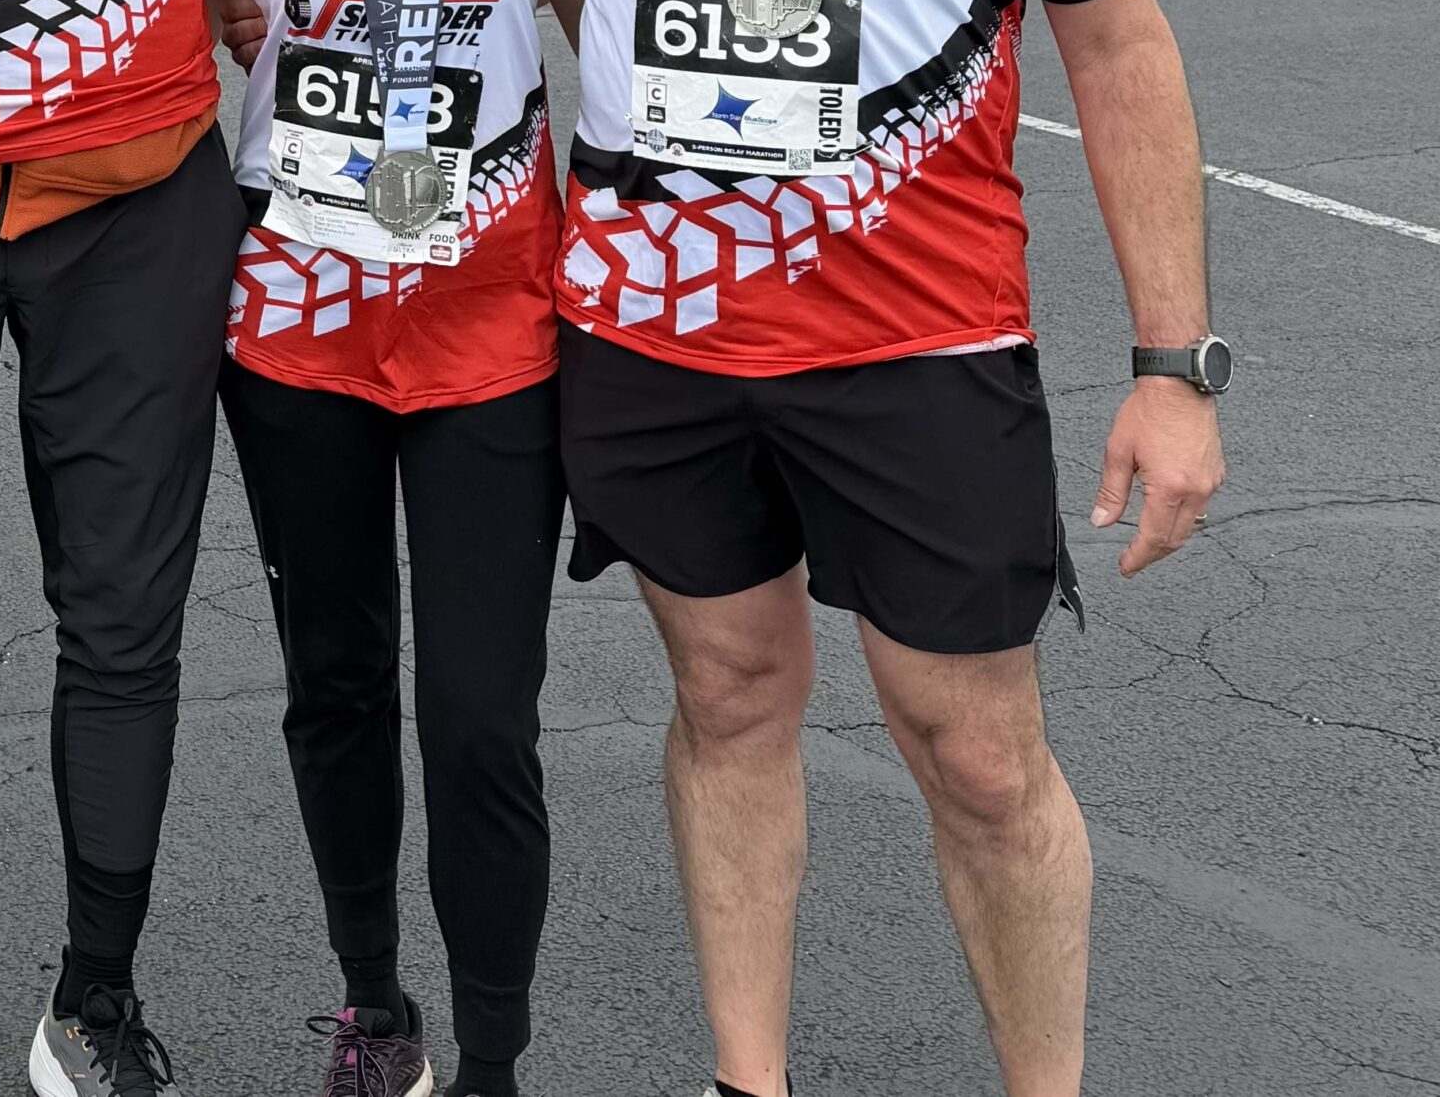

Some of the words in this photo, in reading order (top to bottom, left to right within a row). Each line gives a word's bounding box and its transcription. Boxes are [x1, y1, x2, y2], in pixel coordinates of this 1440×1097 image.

[339, 4, 494, 30] SDER
[438, 32, 480, 47] OIL
[655, 0, 831, 68] 6153
[352, 56, 374, 66] APRIL
[377, 47, 389, 83] 4.26.26
[392, 76, 429, 84] FINISHER
[651, 87, 662, 101] C
[819, 87, 843, 153] TOLEDO
[691, 143, 723, 153] 5-PERSON
[724, 147, 745, 156] RELAY
[746, 150, 784, 159] MARATHON
[350, 201, 366, 210] RELA
[391, 229, 422, 241] DRINK
[429, 233, 456, 244] FOOD
